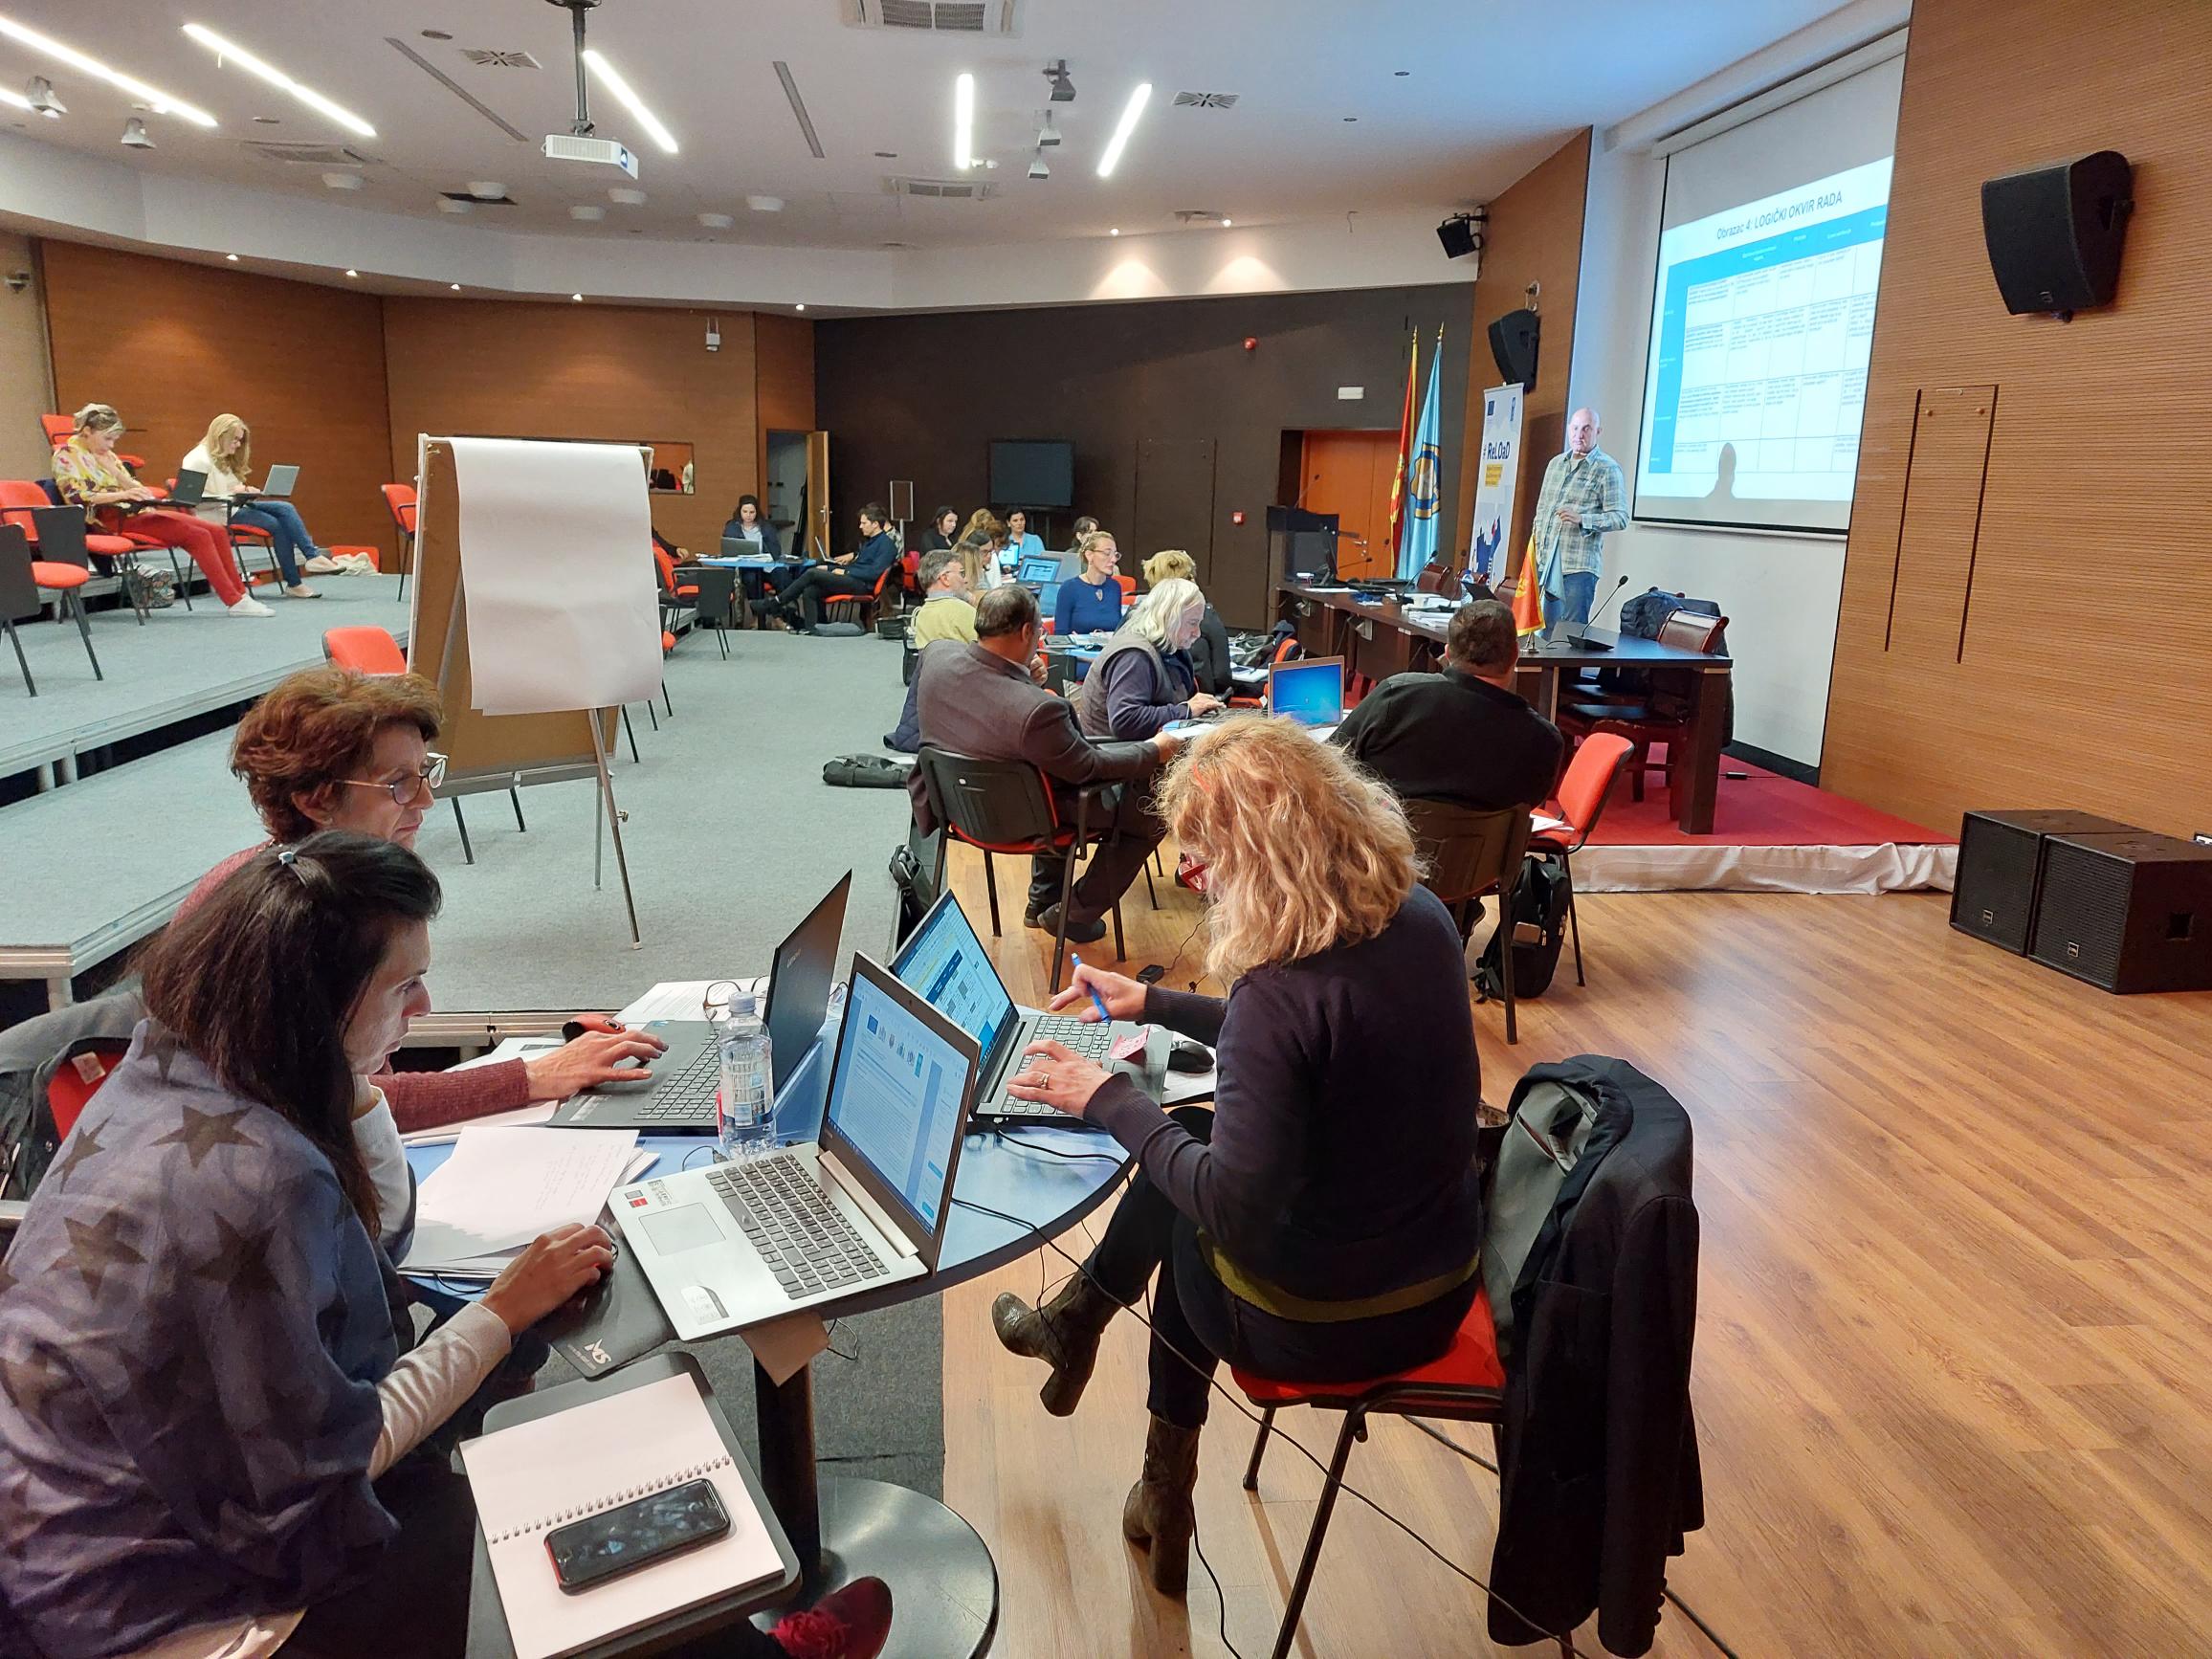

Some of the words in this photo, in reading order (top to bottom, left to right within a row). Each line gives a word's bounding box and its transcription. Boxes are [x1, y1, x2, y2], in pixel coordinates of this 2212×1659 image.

[1716, 223, 1744, 240] Obrazac
[1755, 207, 1786, 229] LOGIČKI
[1788, 199, 1815, 219] OKVIR
[1816, 190, 1843, 210] RADA
